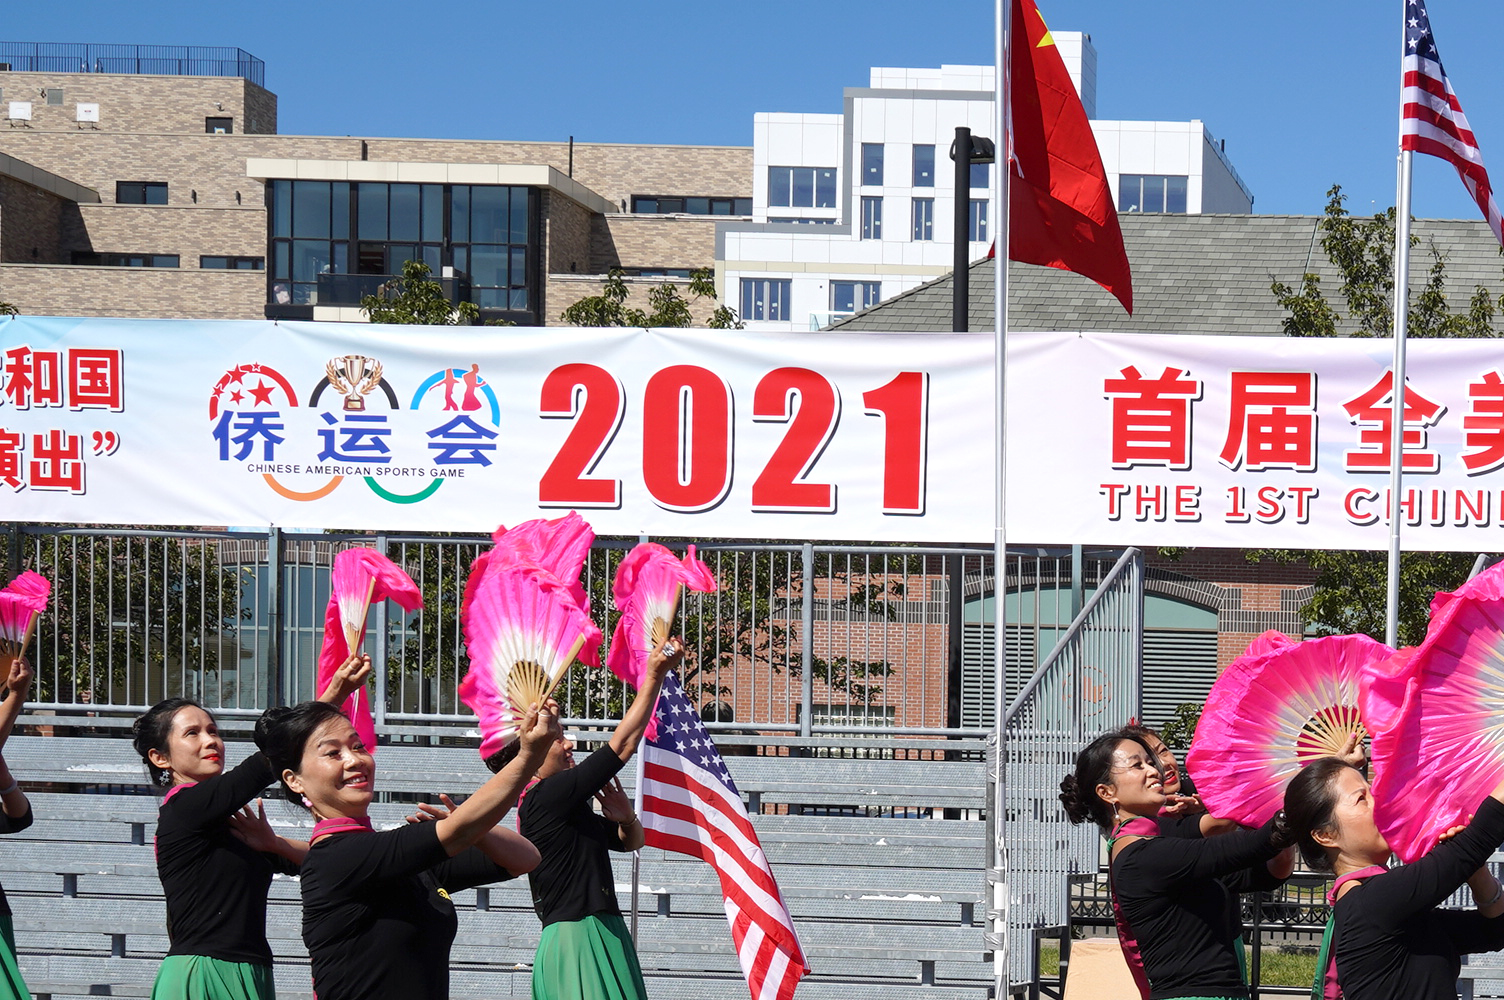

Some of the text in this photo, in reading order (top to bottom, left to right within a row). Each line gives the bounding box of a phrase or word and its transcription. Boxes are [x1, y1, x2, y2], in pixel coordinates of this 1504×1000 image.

[4, 345, 123, 411] 和国
[538, 361, 927, 513] 2021
[247, 463, 466, 478] CHINESE AMERICAN SPORTS GAME
[1099, 483, 1199, 520] THE
[1224, 485, 1316, 521] 1ST
